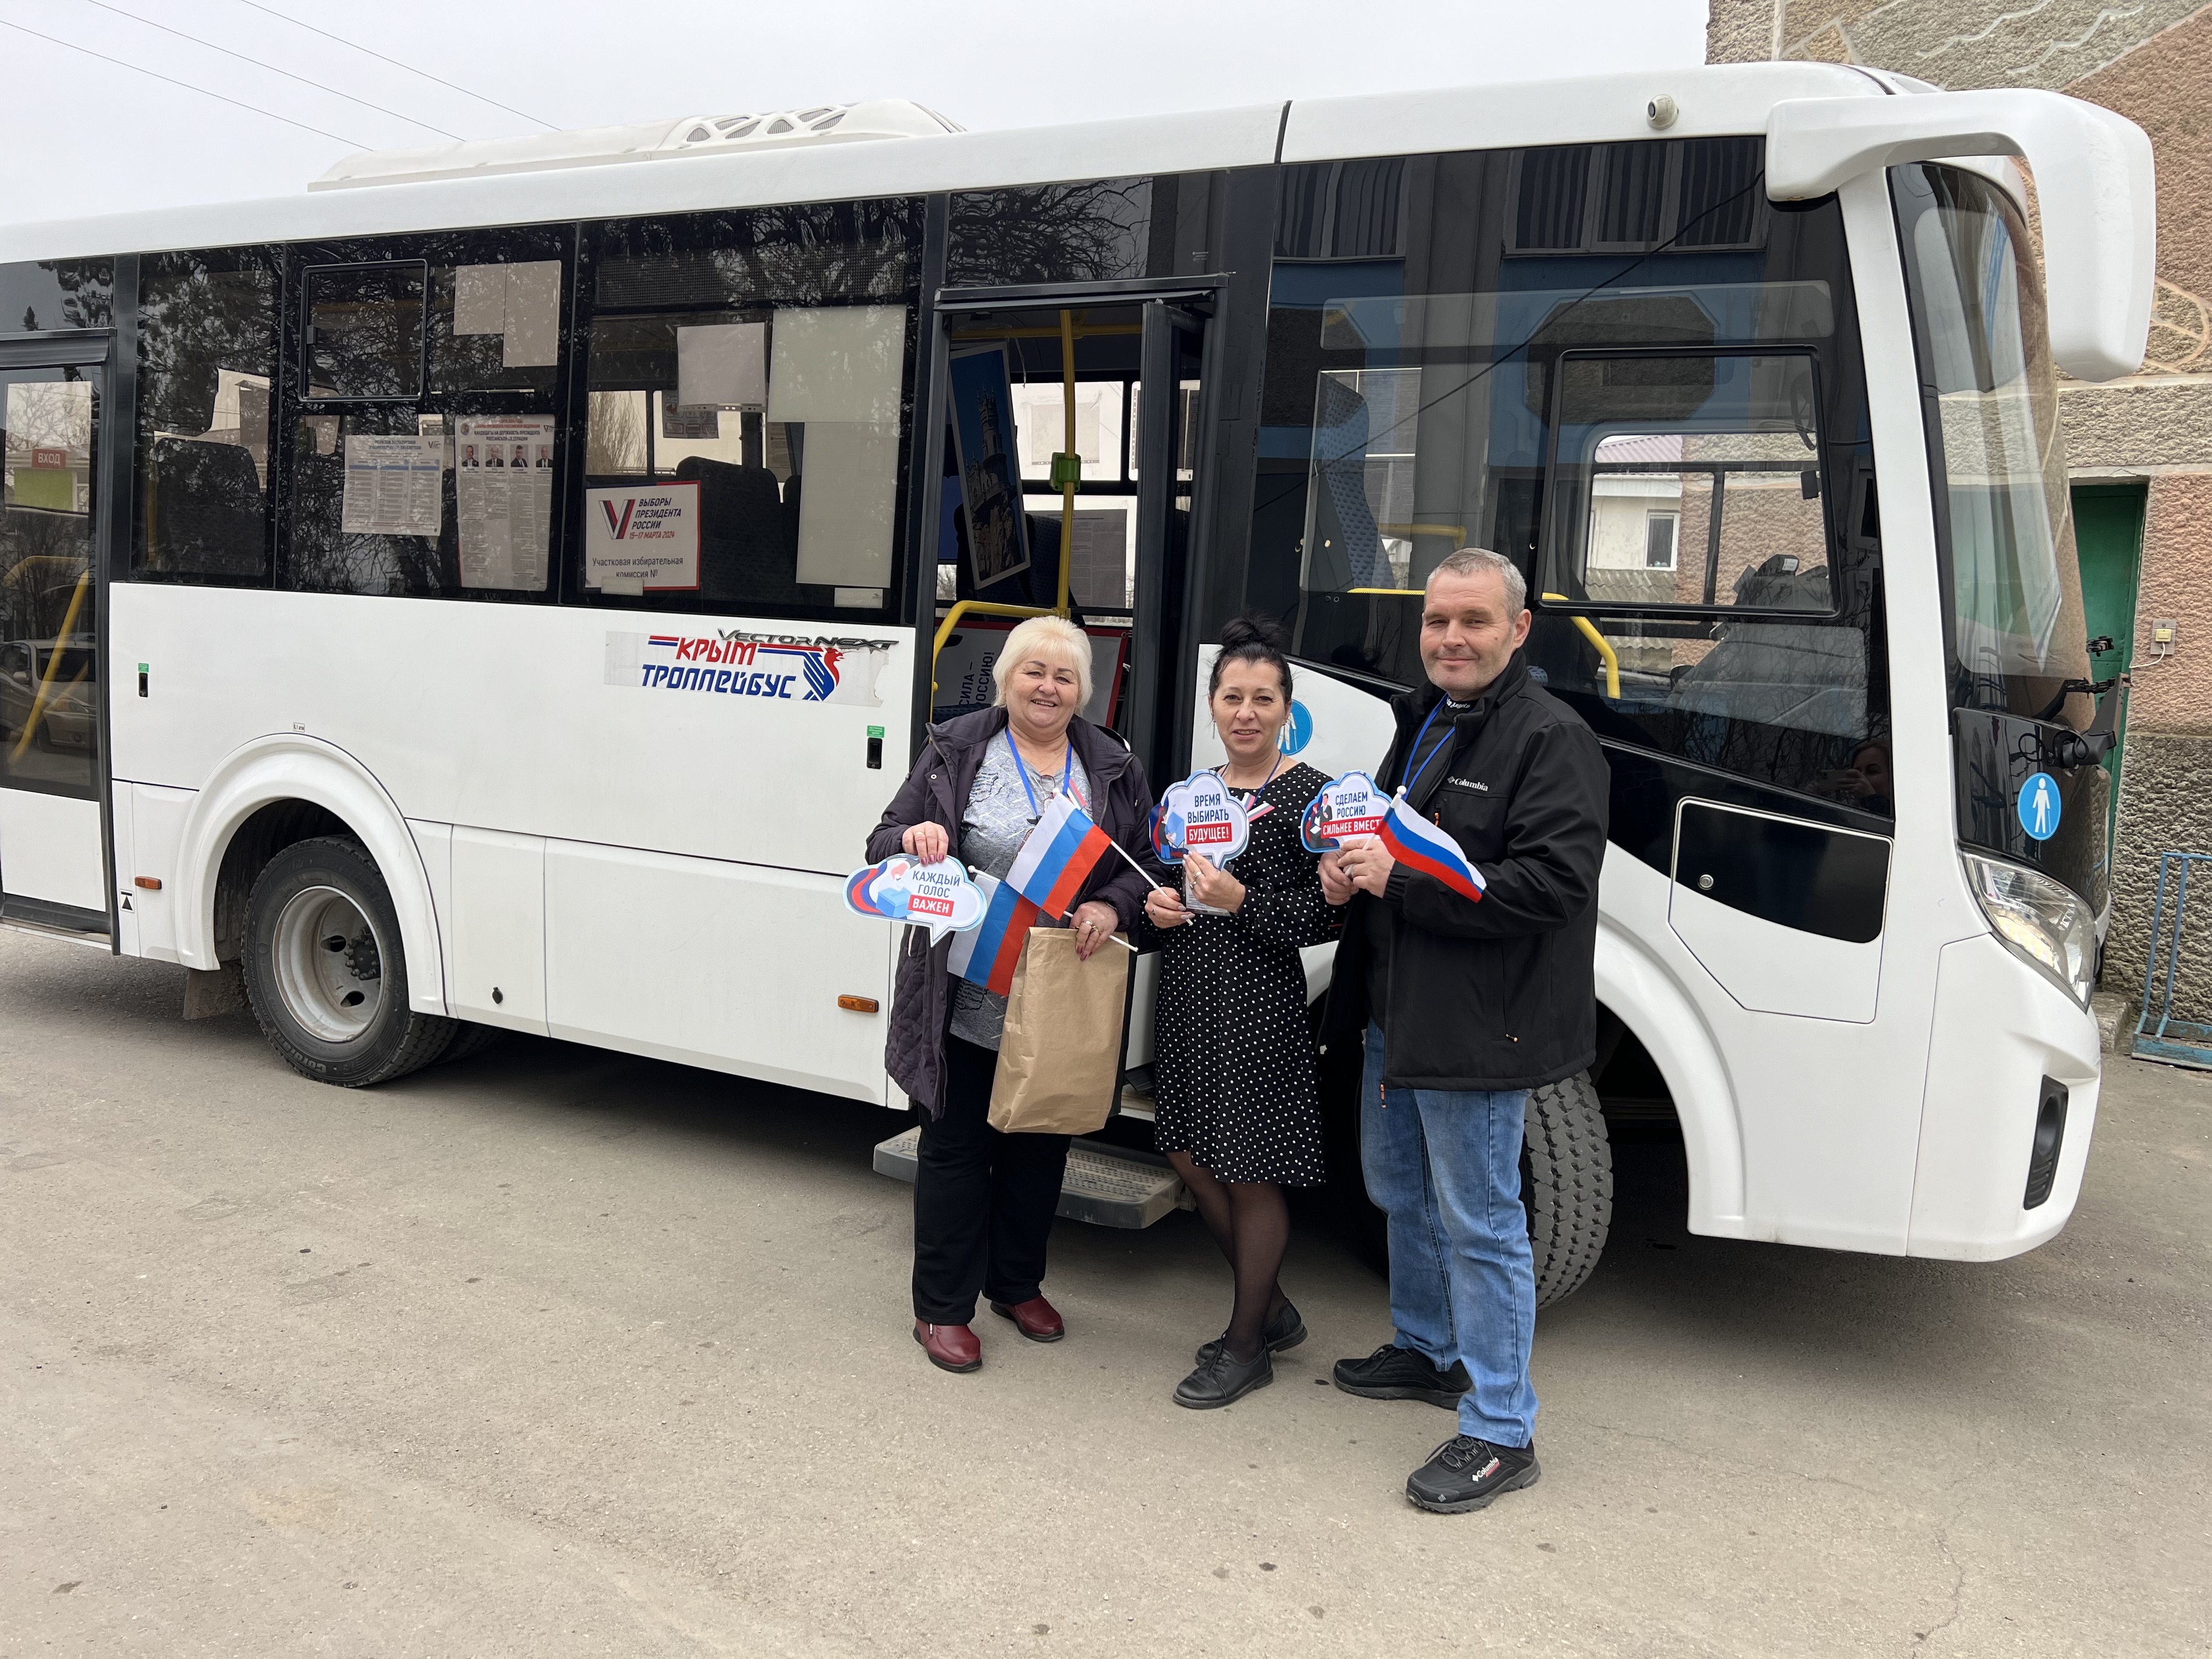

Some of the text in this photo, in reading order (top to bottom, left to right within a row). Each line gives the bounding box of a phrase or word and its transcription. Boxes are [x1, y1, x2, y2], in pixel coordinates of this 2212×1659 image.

[38, 453, 60, 465] ВХОД
[639, 498, 672, 507] ВЫБОРЫ
[635, 509, 681, 518] ПРЕЗИДЕНТА
[631, 521, 662, 530] РОССИИ
[644, 531, 661, 539] МАРТА
[662, 531, 675, 539] 2024
[592, 556, 683, 567] Участковая избирательная
[675, 637, 758, 665] КРЫМ
[641, 664, 797, 699] ТРОЛЛЕЙБУС
[958, 674, 975, 706] СИЛА
[1454, 778, 1488, 792] Columbia
[1194, 793, 1221, 807] ВРЕМЯ
[1335, 791, 1368, 806] СДЕЛАЕМ
[1188, 809, 1229, 823] ВЫБИРАТЬ
[1337, 805, 1365, 819] РОССИЮ
[1189, 826, 1229, 842] БУДУЩЕЕ!
[1323, 819, 1382, 836] СИЛЬНЕЕ ВМЕСТ
[912, 870, 960, 887] КАЖДЫЙ
[918, 884, 950, 898] ГОЛОС
[912, 898, 950, 913] ВАЖЕН
[1477, 1457, 1499, 1478] Columbia
